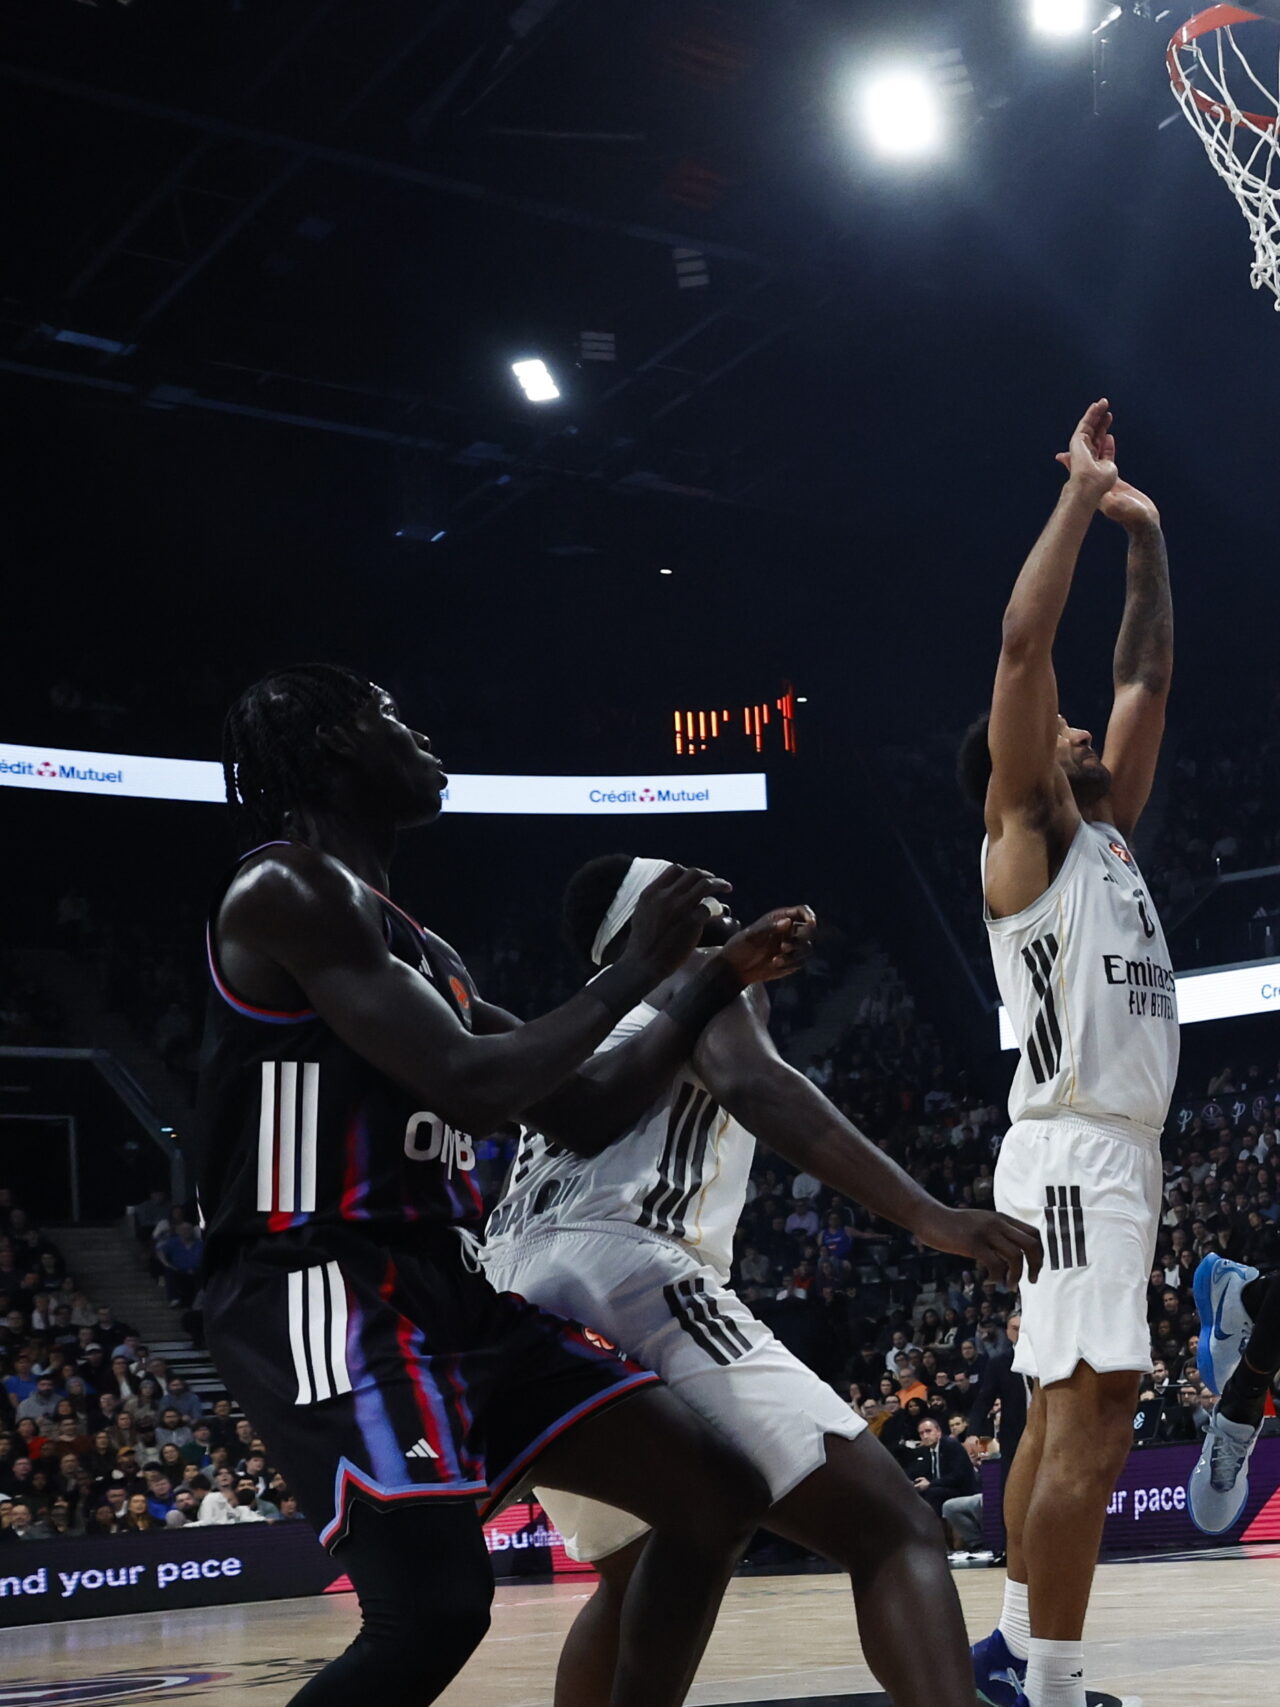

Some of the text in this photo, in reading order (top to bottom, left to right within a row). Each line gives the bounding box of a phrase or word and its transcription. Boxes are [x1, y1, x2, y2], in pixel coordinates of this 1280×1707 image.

[59, 765, 123, 783] Mutuel
[589, 789, 709, 803] Crédit Mutuel
[1103, 954, 1176, 993] Emiraes
[1129, 990, 1147, 1015] FLY
[1134, 1485, 1186, 1520] pace
[58, 1564, 146, 1598] your
[157, 1556, 242, 1589] pace
